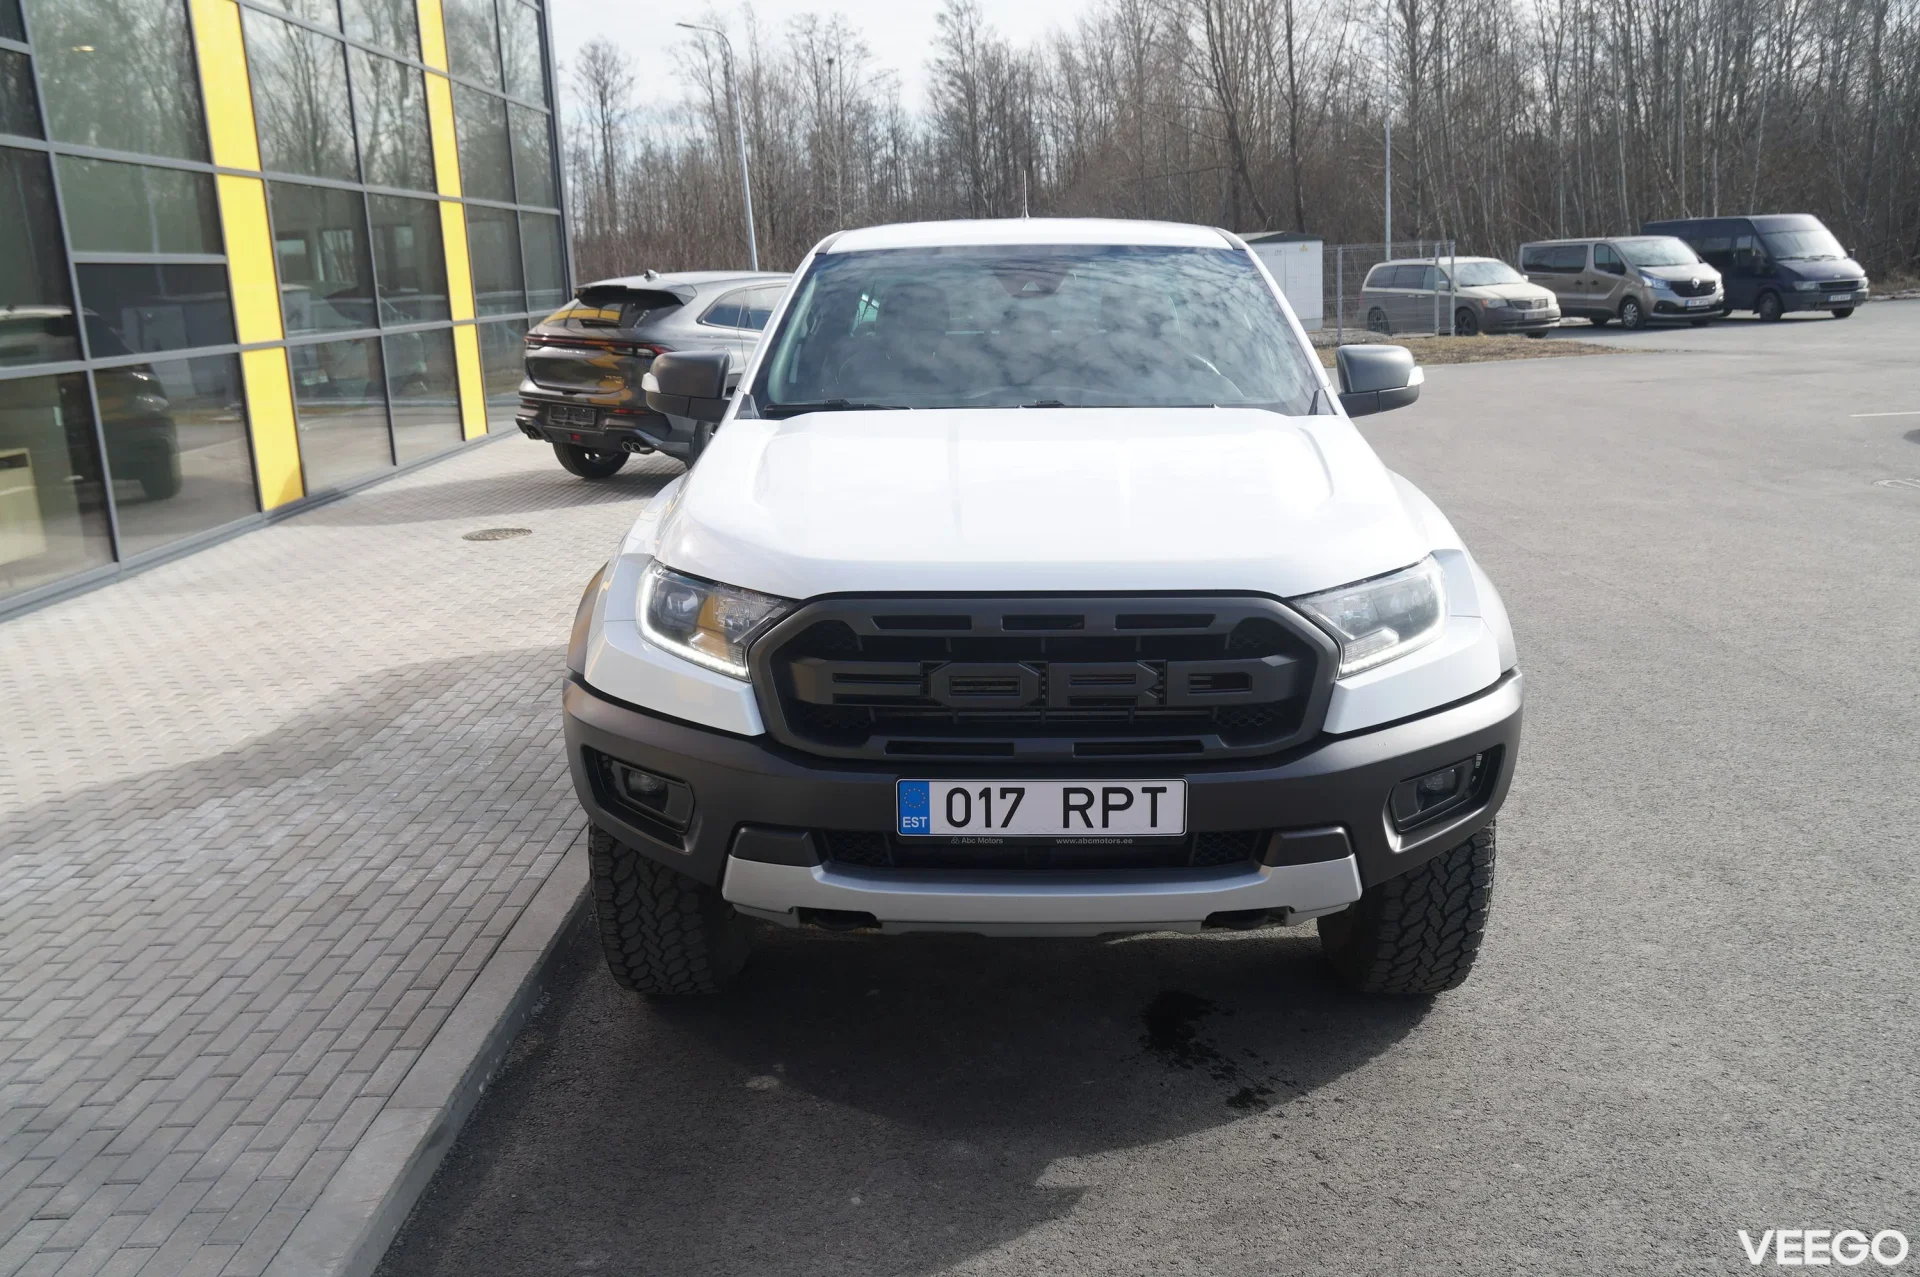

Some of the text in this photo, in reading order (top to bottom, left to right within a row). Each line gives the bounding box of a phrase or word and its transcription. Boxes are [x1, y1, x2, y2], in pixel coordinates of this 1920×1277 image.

[790, 656, 1298, 709] FORD
[946, 787, 1167, 828] 017 RPT
[903, 816, 927, 828] EST
[961, 836, 1003, 844] Abc Motors
